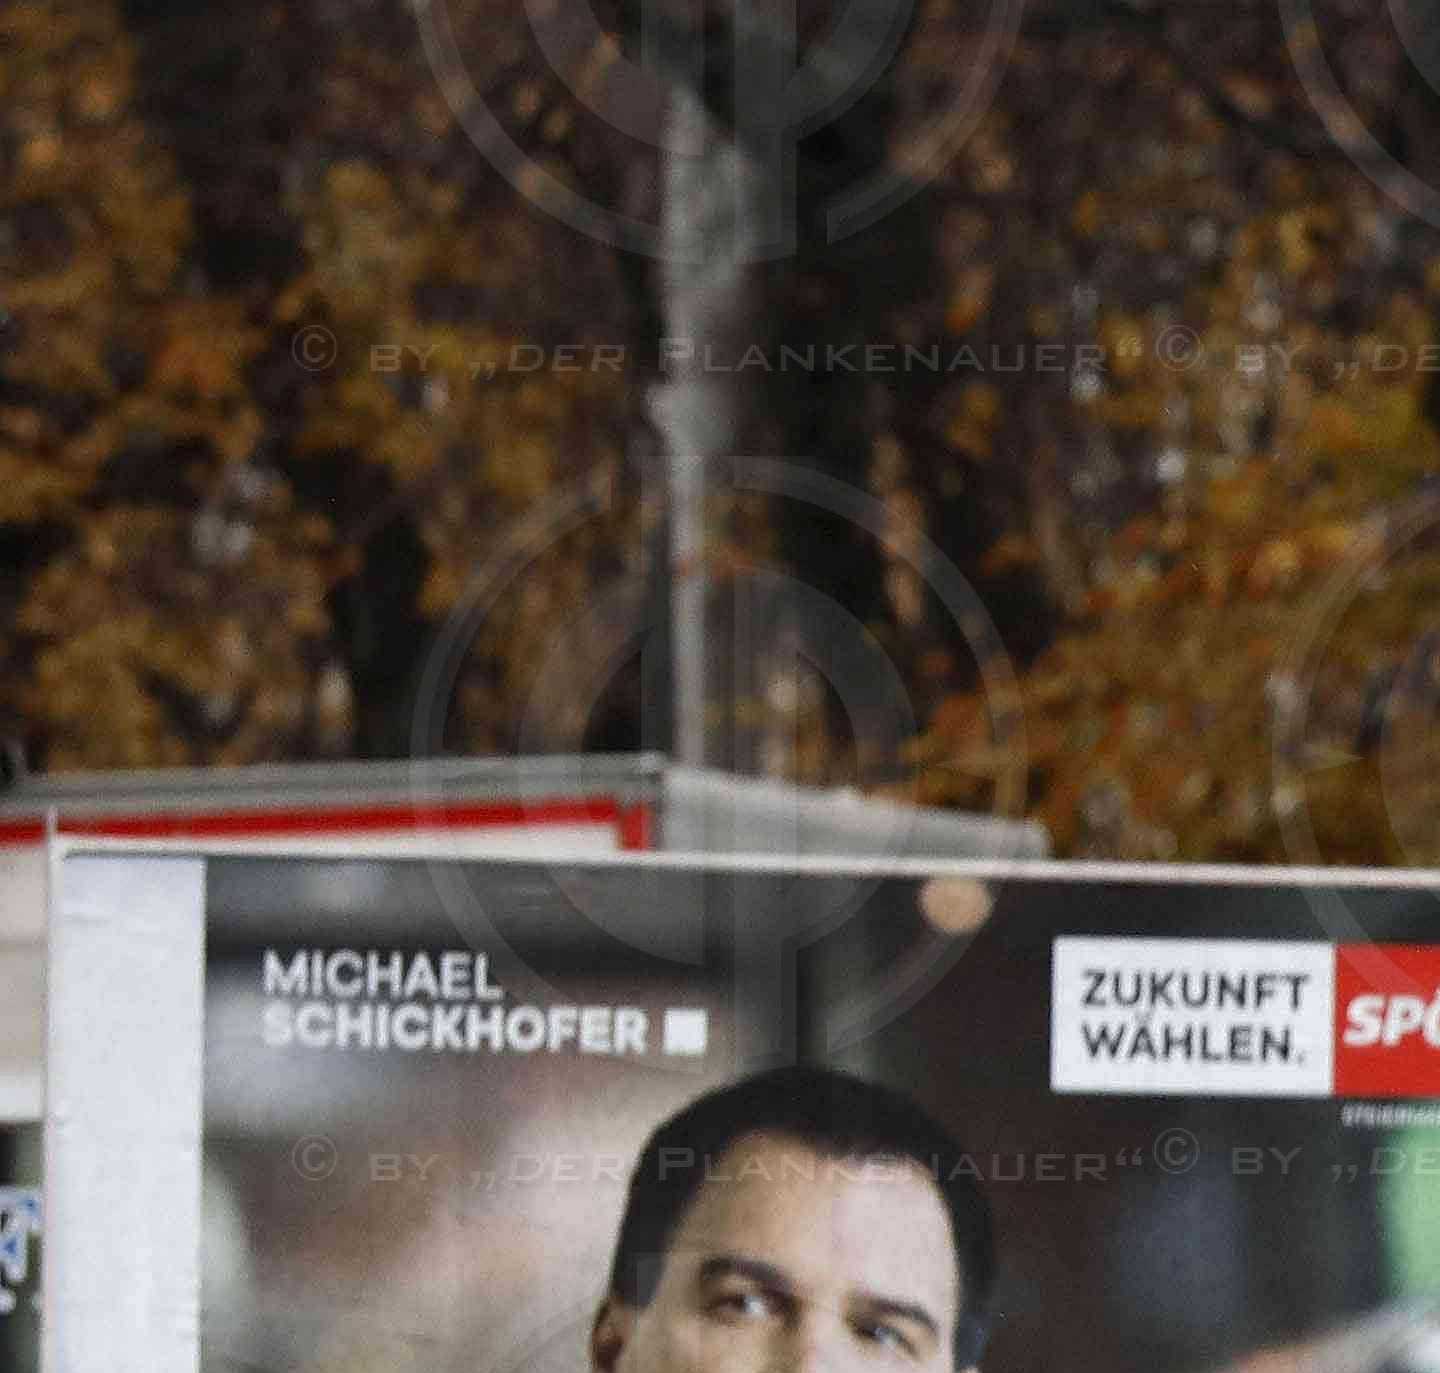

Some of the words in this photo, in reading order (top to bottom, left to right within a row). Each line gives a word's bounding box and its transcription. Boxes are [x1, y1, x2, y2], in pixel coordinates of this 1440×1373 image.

[262, 949, 501, 999] MICHAEL
[1081, 968, 1311, 1010] ZUKUNFT
[262, 1002, 648, 1053] SCHICKHOFER
[1081, 1014, 1305, 1064] WÄHLEN.
